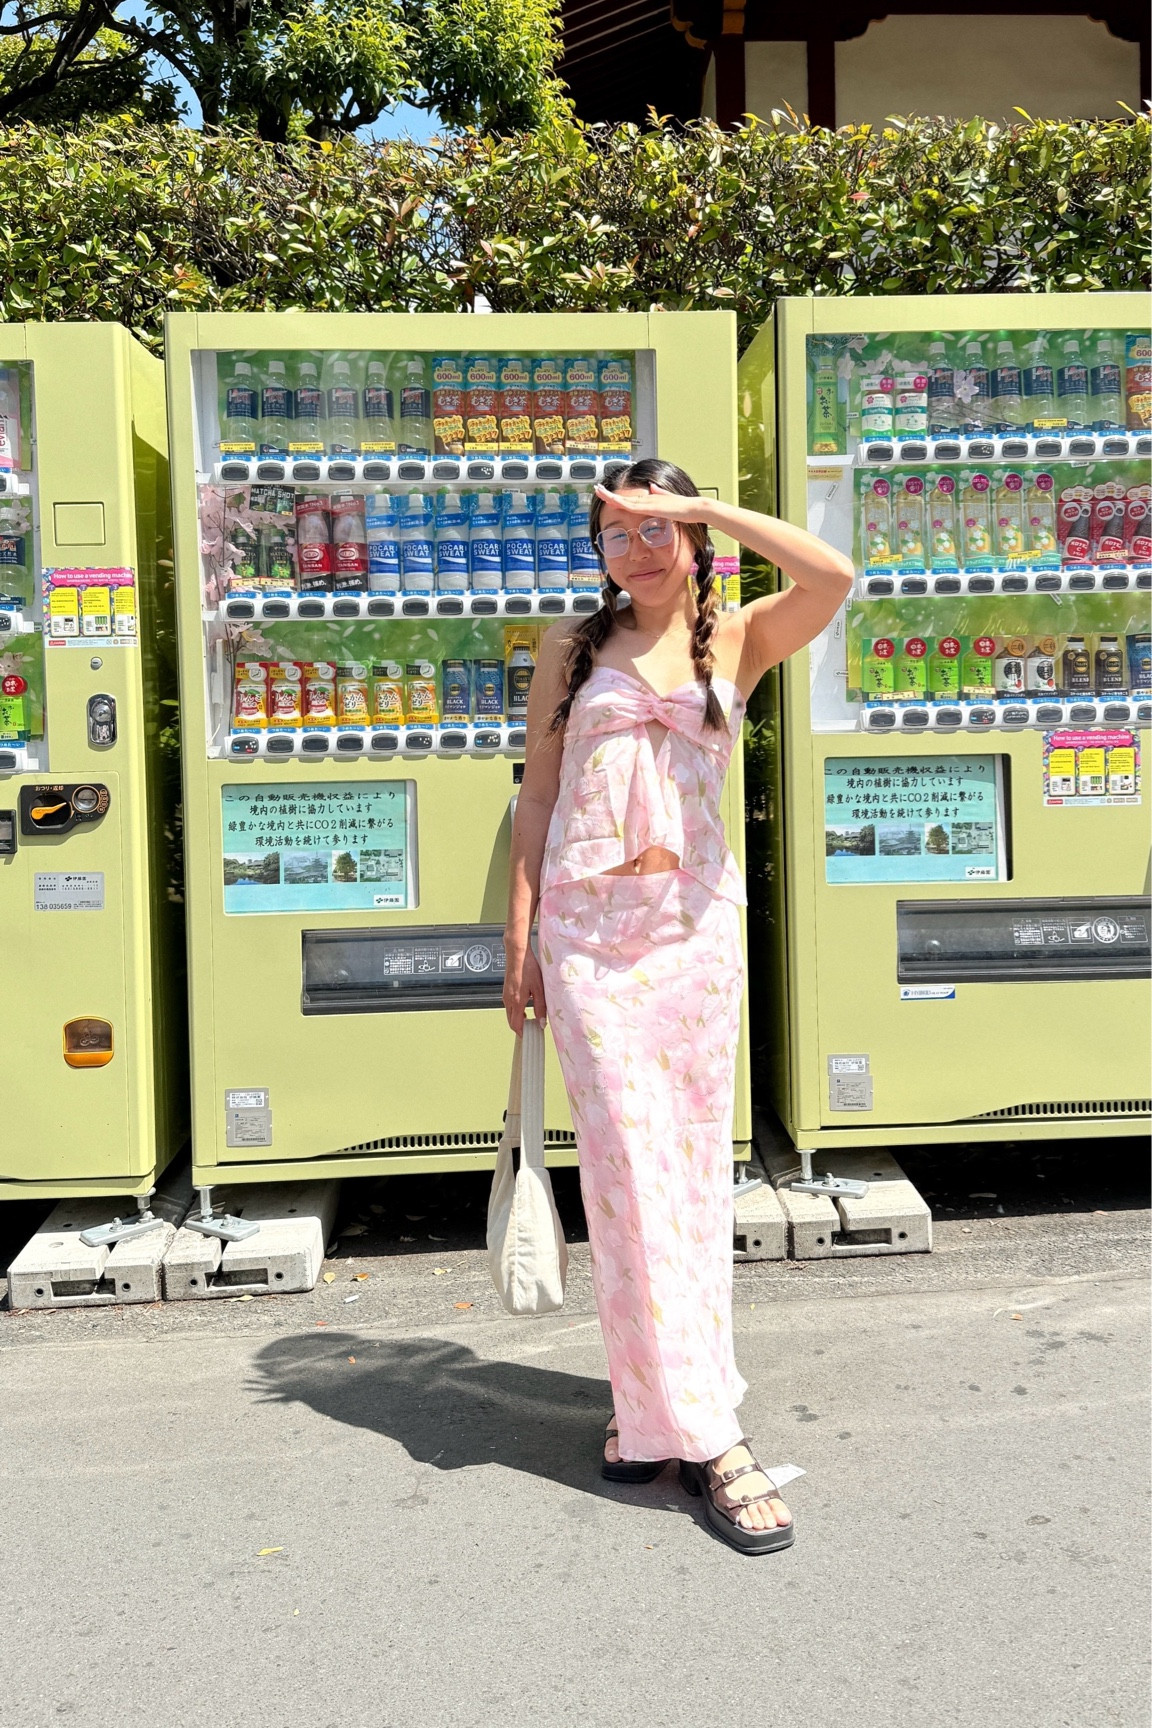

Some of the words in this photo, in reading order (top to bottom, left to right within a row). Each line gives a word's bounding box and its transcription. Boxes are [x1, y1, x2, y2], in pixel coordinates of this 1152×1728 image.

[437, 373, 460, 381] 600ml
[470, 373, 494, 381] 600ml
[504, 373, 528, 381] 600ml
[536, 373, 560, 381] 600ml
[569, 373, 593, 381] 600ml
[603, 374, 627, 382] 600ml
[438, 395, 460, 407] むぎ茶
[471, 395, 494, 407] むぎ茶
[505, 395, 528, 407] むぎ茶
[538, 395, 561, 407] むぎ茶
[571, 395, 593, 407] むぎ茶
[604, 396, 626, 408] むぎ茶
[251, 487, 276, 497] MATCHA
[277, 490, 295, 499] SHOT
[344, 700, 363, 708] ゼリー
[824, 764, 986, 776] この自動販売機収益により
[846, 776, 964, 789] 境内の植樹に協力しています
[225, 791, 396, 802] この自動販売機収益により
[249, 803, 373, 816] 境内の植樹に協力しています
[851, 806, 960, 819] 環境活動を続けて参ります
[255, 834, 369, 847] 環境活動を続けて参ります
